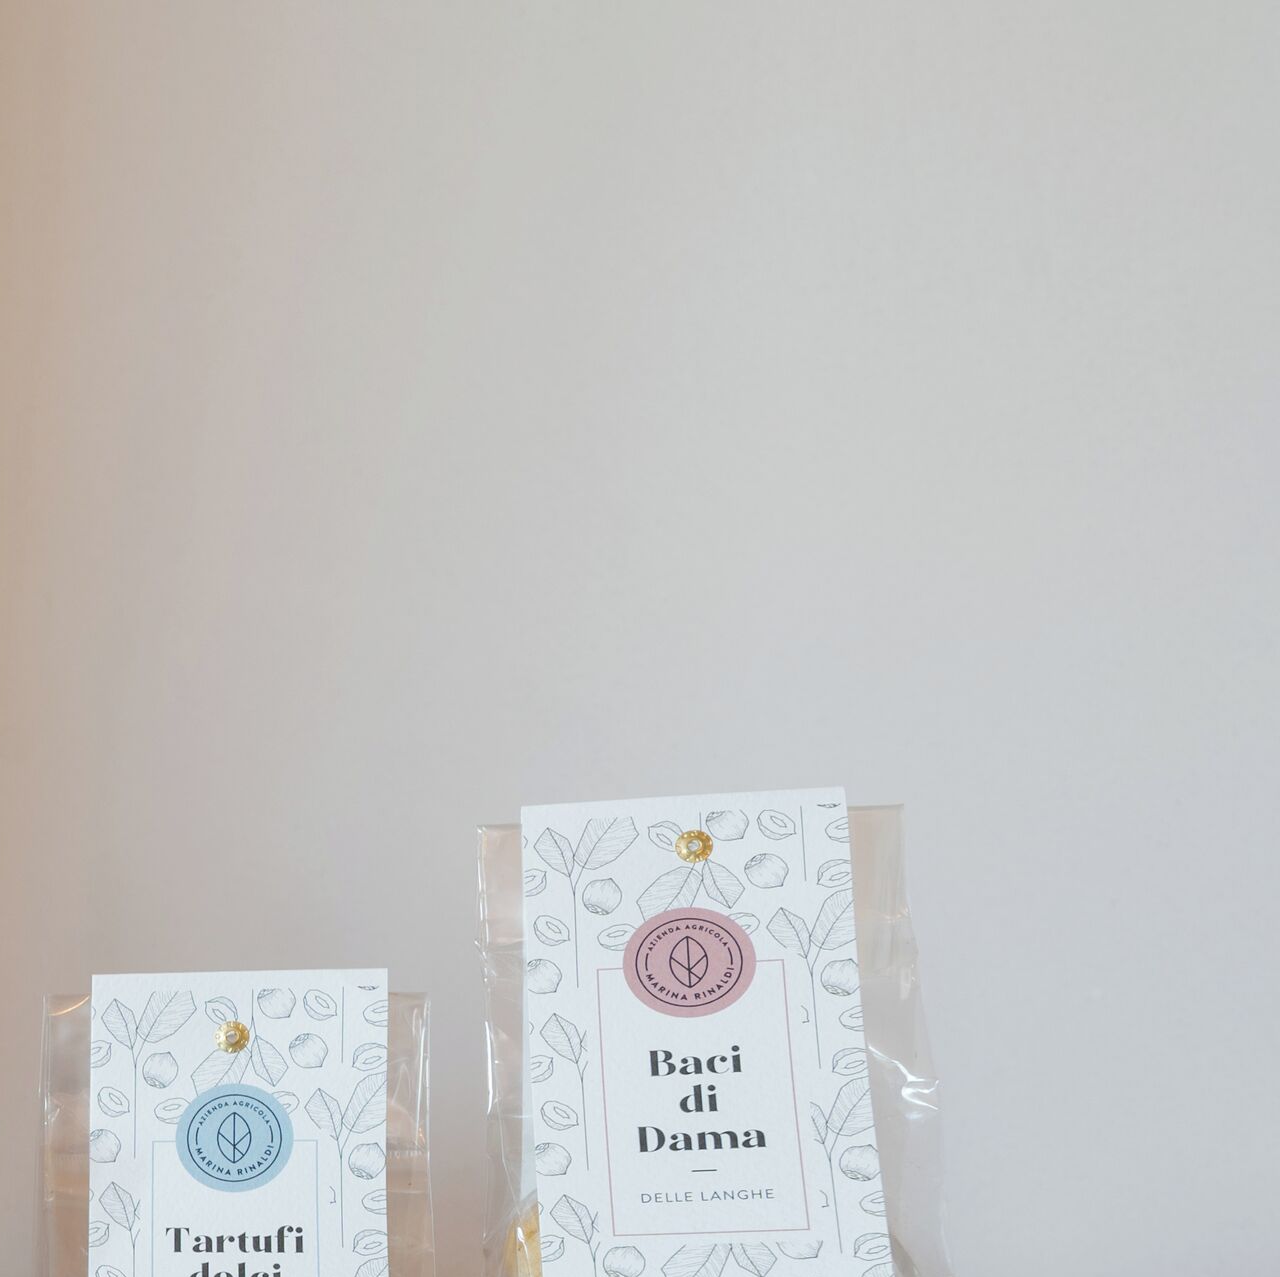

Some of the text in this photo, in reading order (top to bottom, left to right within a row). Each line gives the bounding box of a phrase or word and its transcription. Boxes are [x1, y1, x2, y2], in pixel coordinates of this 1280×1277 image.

[648, 924, 728, 952] AZIENDA AGRICOLA
[646, 967, 735, 1000] MARINA RINALDI
[649, 1045, 742, 1077] Baci
[679, 1084, 718, 1113] di
[199, 1101, 270, 1126] AZIENDA AGRICOLA
[637, 1126, 767, 1153] Dama
[195, 1145, 274, 1176] MARINA RINALDI
[641, 1188, 776, 1204] DELLE LANGHE
[165, 1225, 304, 1253] Tartufi
